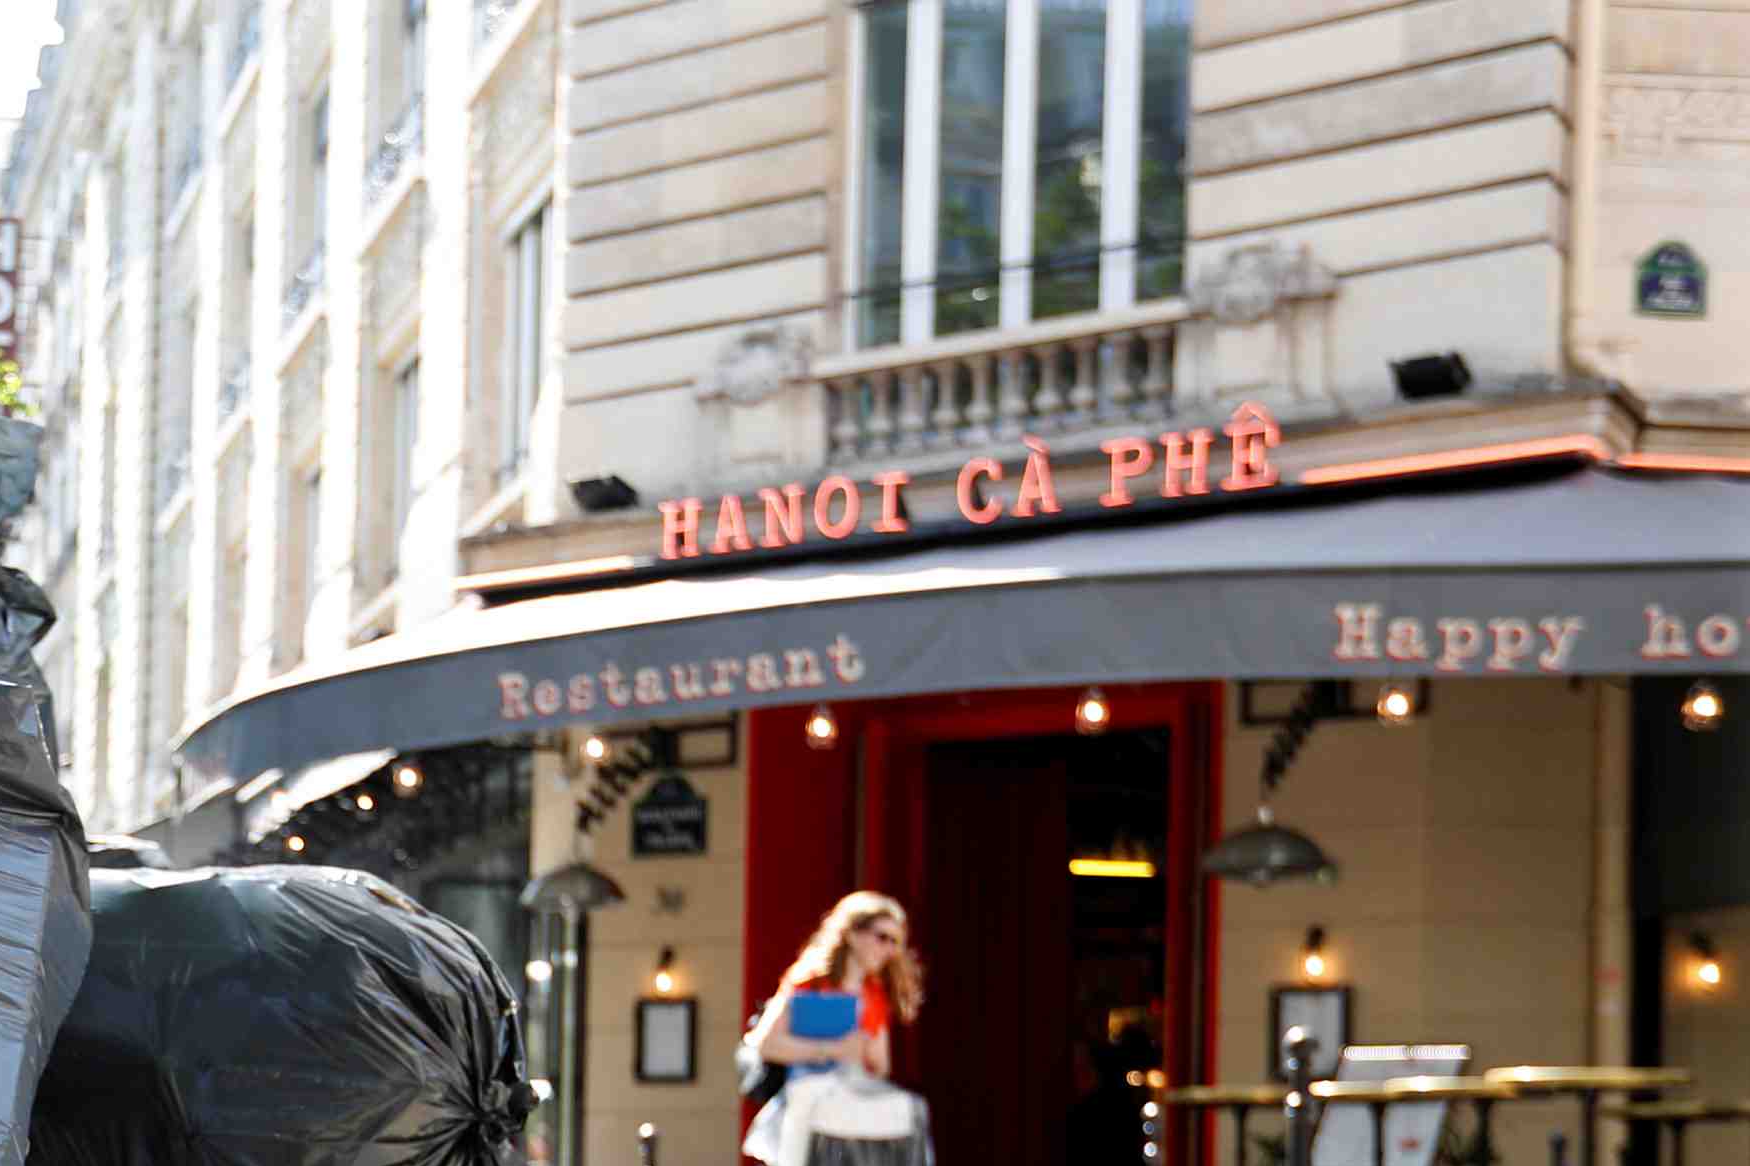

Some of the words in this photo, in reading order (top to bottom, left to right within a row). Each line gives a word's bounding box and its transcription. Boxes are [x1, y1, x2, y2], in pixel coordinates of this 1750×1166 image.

[658, 470, 912, 560] HANOI
[956, 433, 1064, 524] CÀ
[1099, 401, 1281, 507] PHÊ
[497, 634, 866, 720] Restaurant
[1332, 602, 1583, 672] Happy
[1641, 604, 1750, 661] ho
